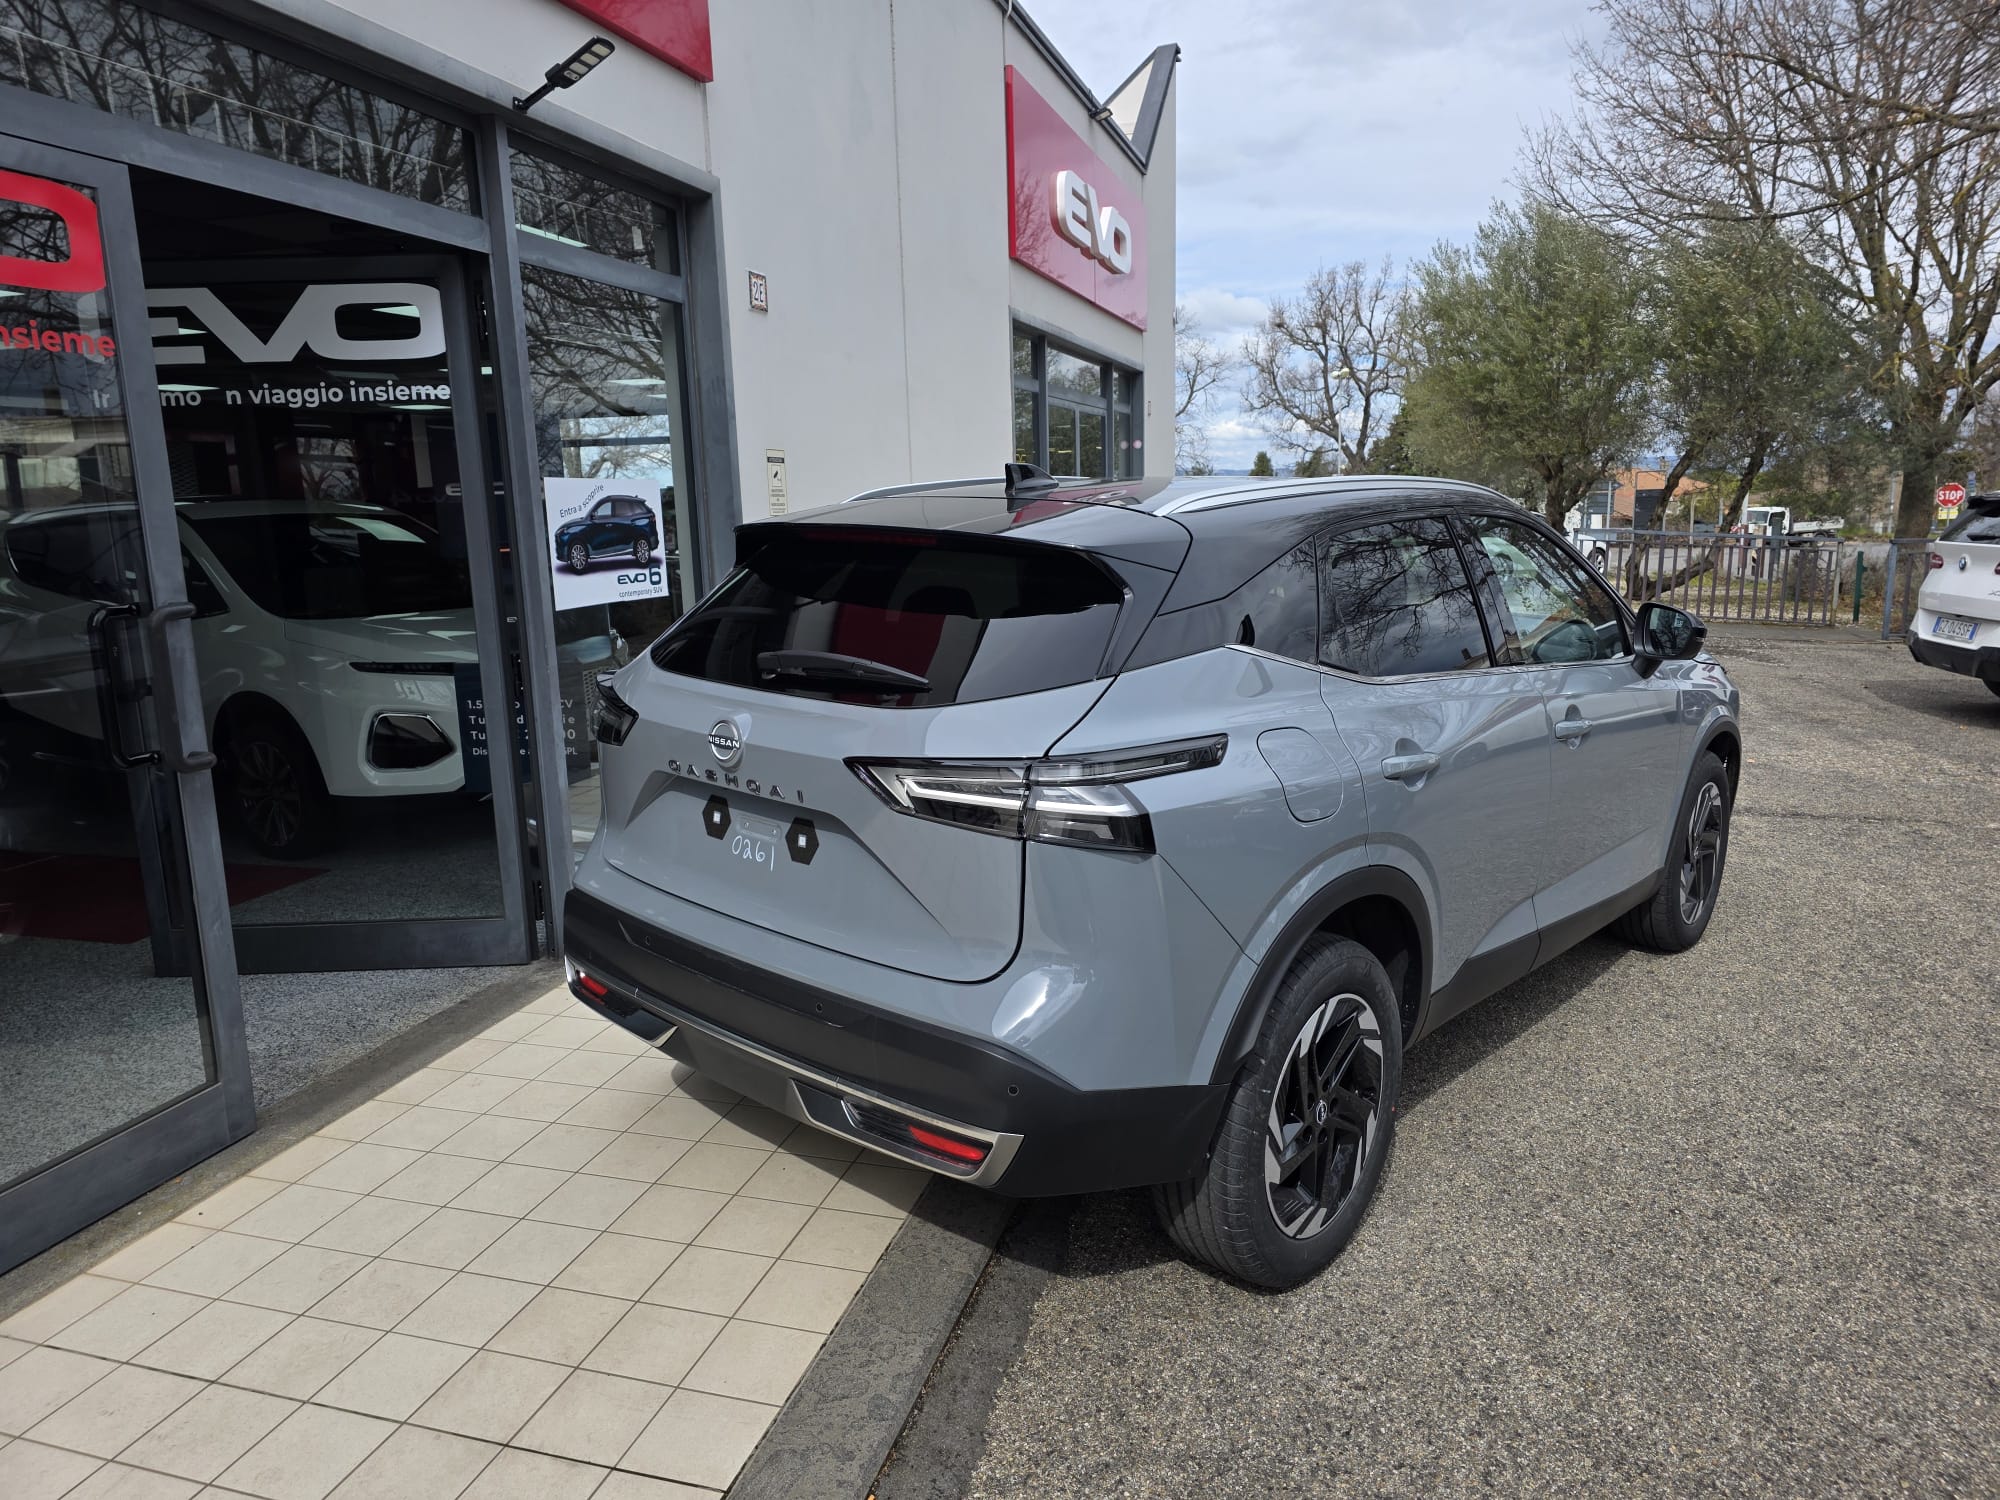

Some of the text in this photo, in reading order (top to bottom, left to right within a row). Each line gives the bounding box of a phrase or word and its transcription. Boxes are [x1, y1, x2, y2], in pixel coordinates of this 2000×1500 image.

[1056, 170, 1132, 274] EVO
[248, 383, 344, 408] viaggio
[350, 380, 451, 402] insieme
[560, 506, 578, 518] Entra
[582, 484, 604, 508] scoprire
[1938, 489, 1963, 501] STOP
[617, 564, 662, 585] EVO 6
[709, 735, 740, 749] NISSAN
[668, 759, 804, 803] QASHQAI
[731, 835, 775, 872] 0261
